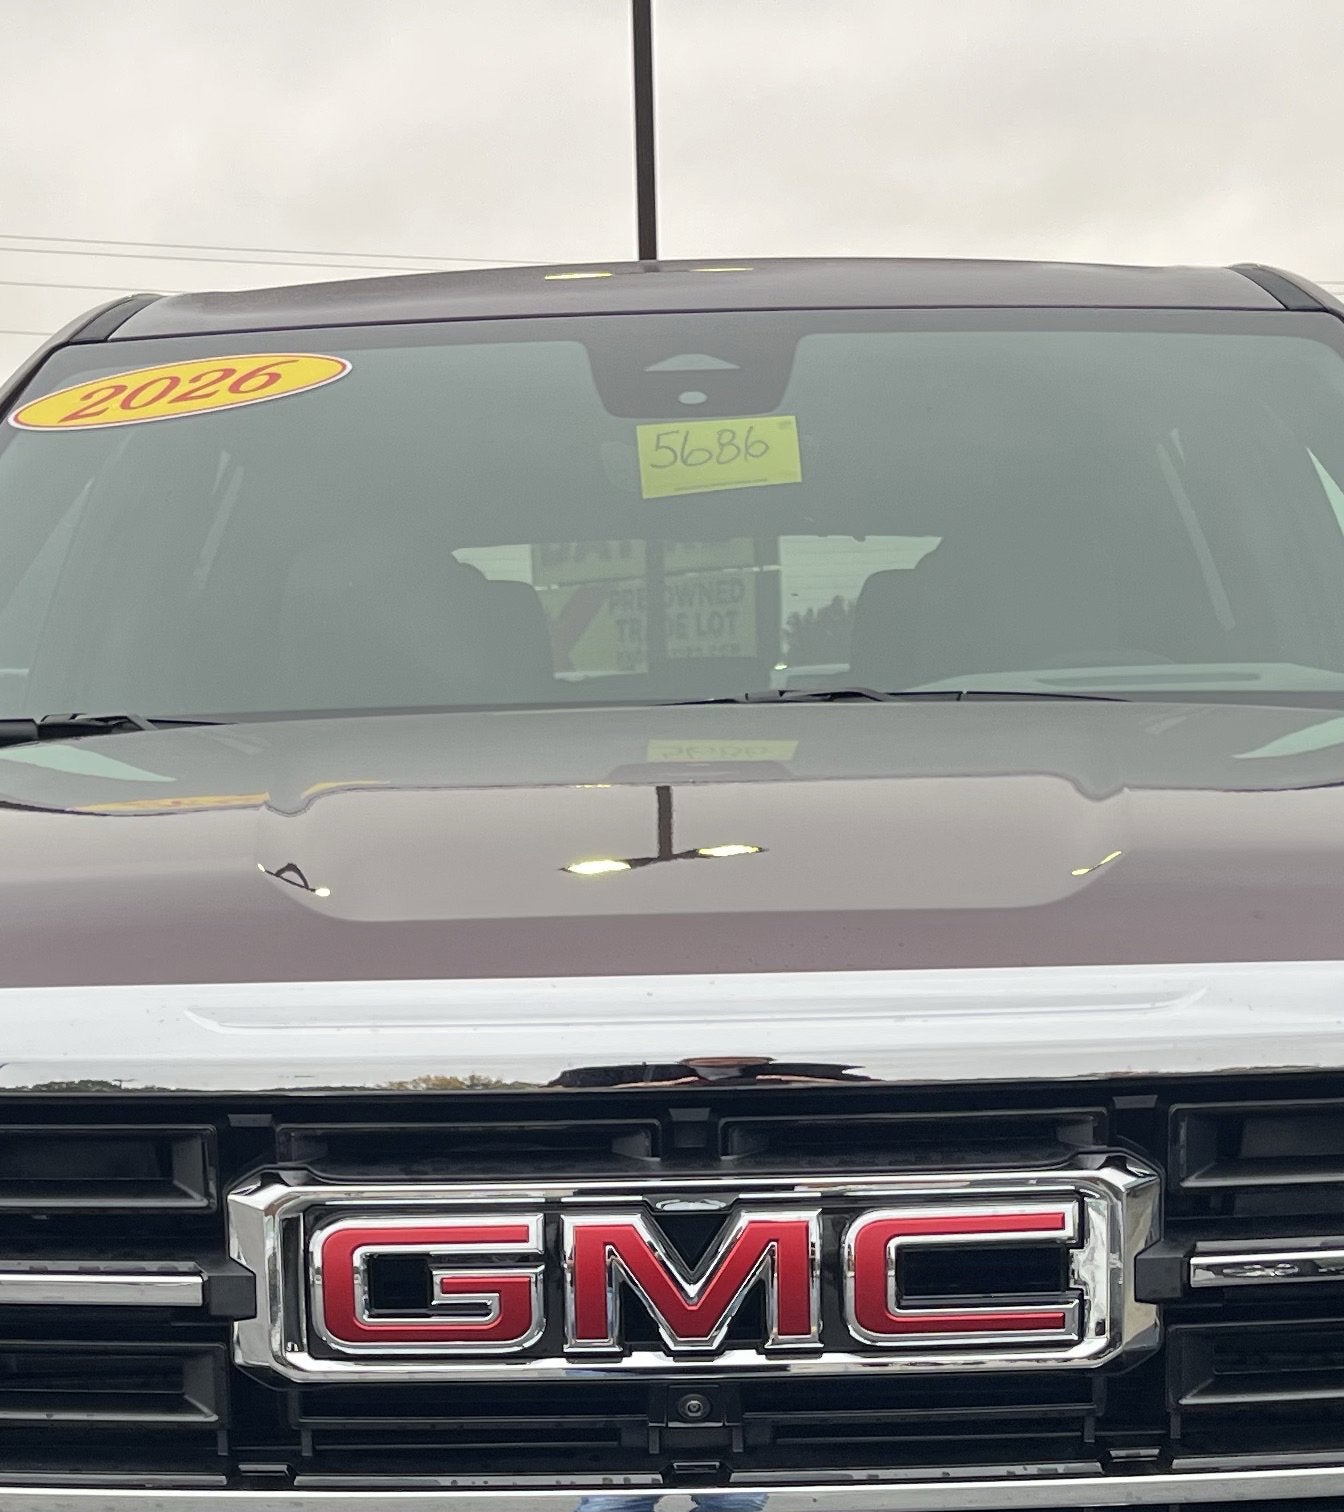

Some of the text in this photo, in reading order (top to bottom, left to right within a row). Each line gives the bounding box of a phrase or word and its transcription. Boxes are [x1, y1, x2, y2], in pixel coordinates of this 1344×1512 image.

[56, 359, 299, 423] 2026
[650, 426, 770, 468] 5686
[311, 1207, 1080, 1353] GMC
